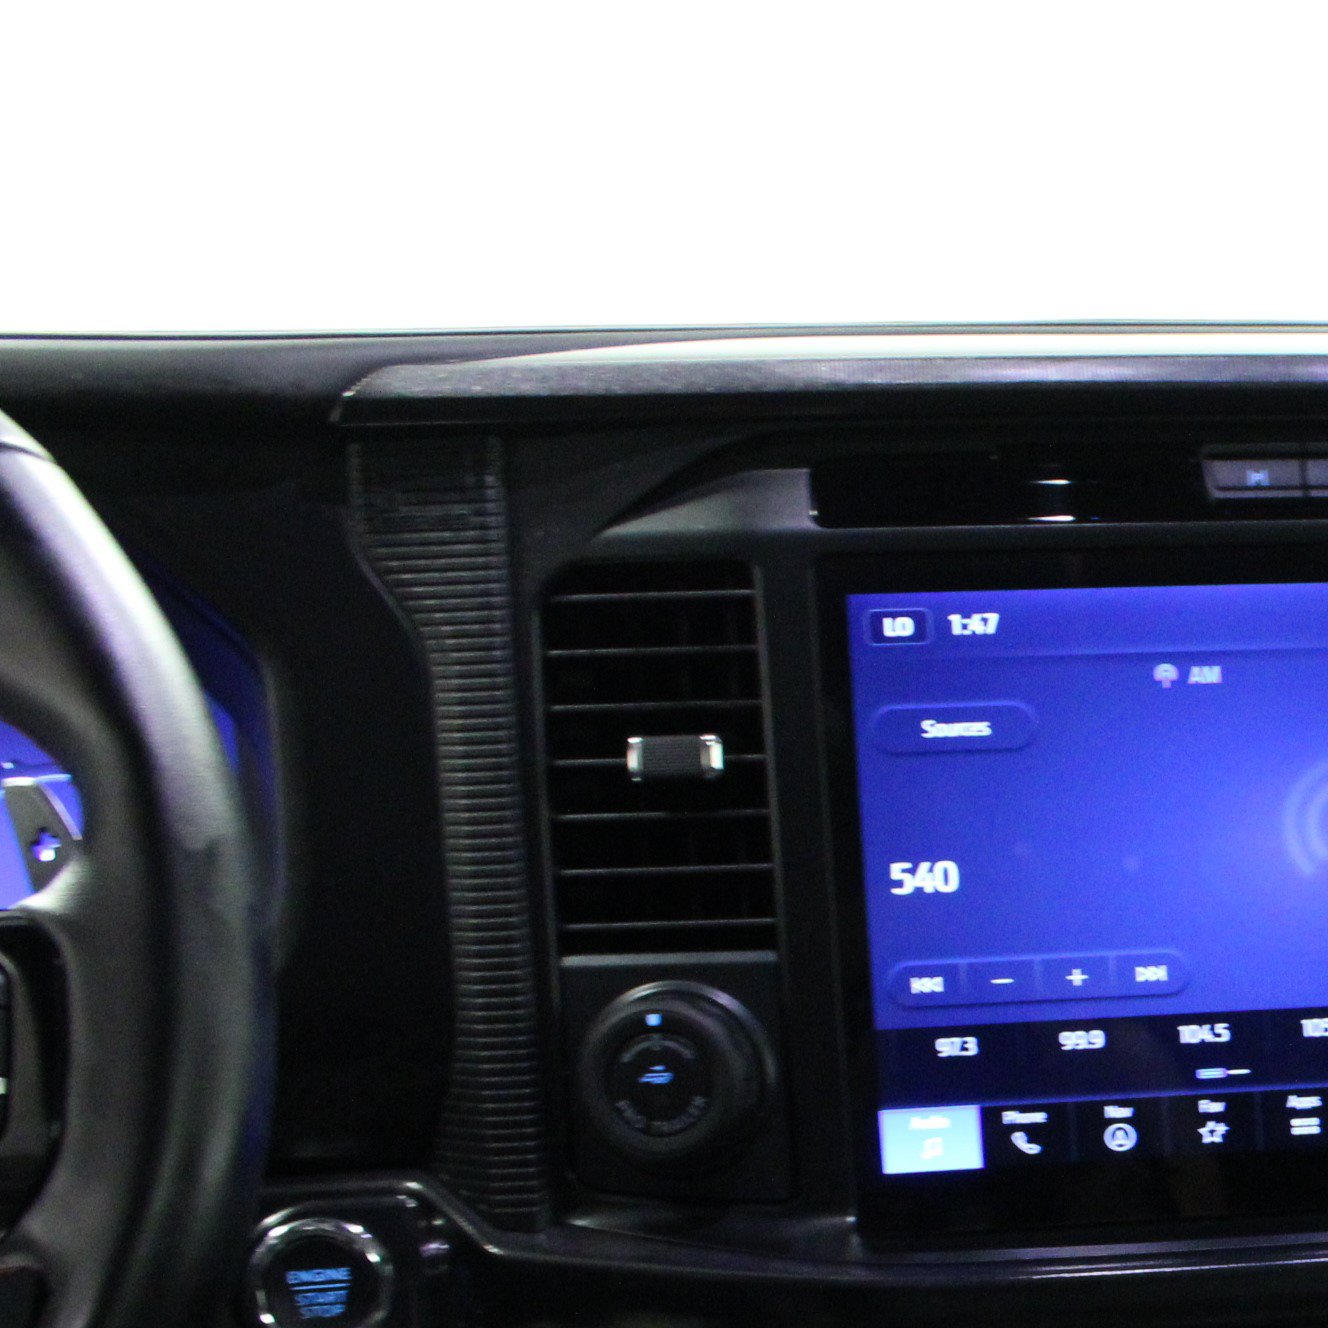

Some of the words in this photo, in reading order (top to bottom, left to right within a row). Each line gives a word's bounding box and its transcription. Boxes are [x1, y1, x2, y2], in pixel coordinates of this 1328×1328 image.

[947, 612, 1000, 636] 1:47
[1187, 665, 1223, 684] AM
[889, 860, 960, 895] 540
